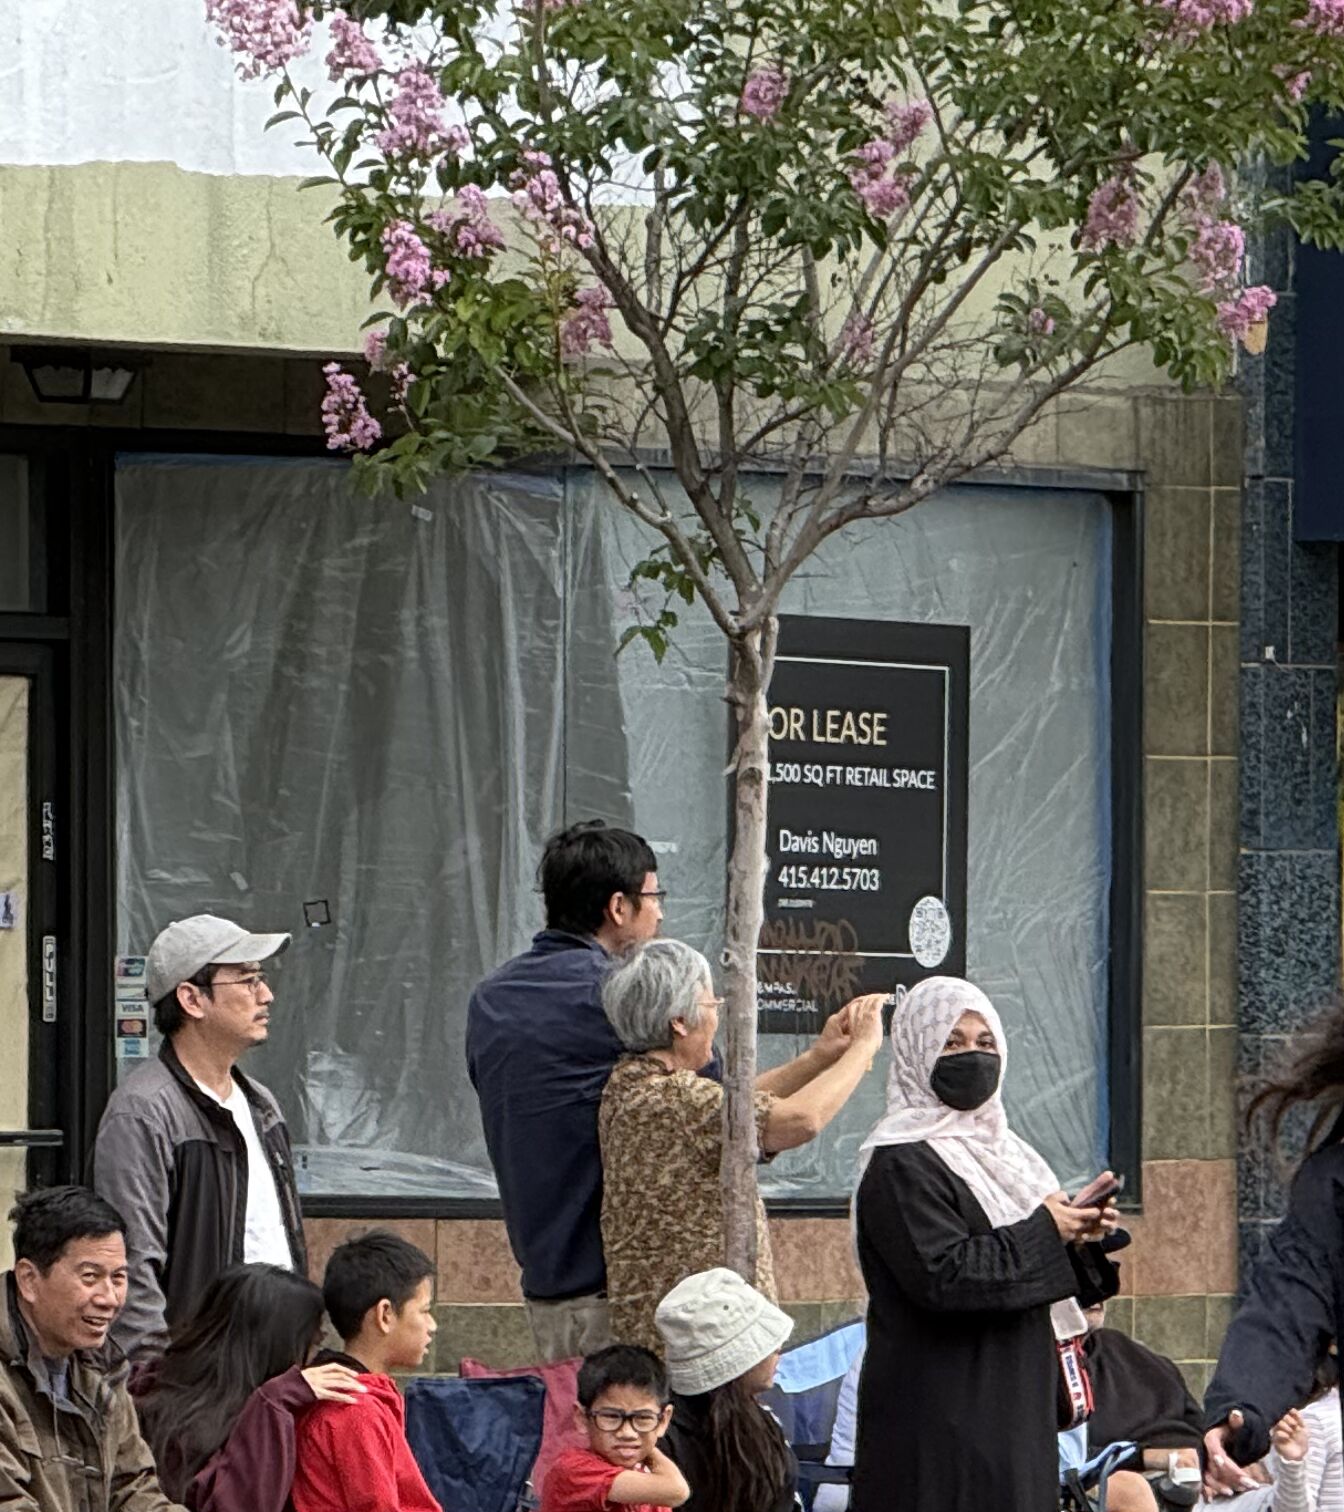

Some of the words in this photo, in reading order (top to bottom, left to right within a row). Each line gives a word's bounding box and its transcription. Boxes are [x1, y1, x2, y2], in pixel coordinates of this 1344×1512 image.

[768, 706, 806, 742] OR
[813, 709, 888, 746] LEASE
[803, 764, 824, 787] SQ
[826, 765, 843, 785] FT
[845, 766, 891, 787] RETAIL
[892, 769, 937, 790] SPACE
[779, 829, 820, 853] Davis
[822, 831, 877, 860] Nguyen
[778, 865, 880, 891] 415.412.5703
